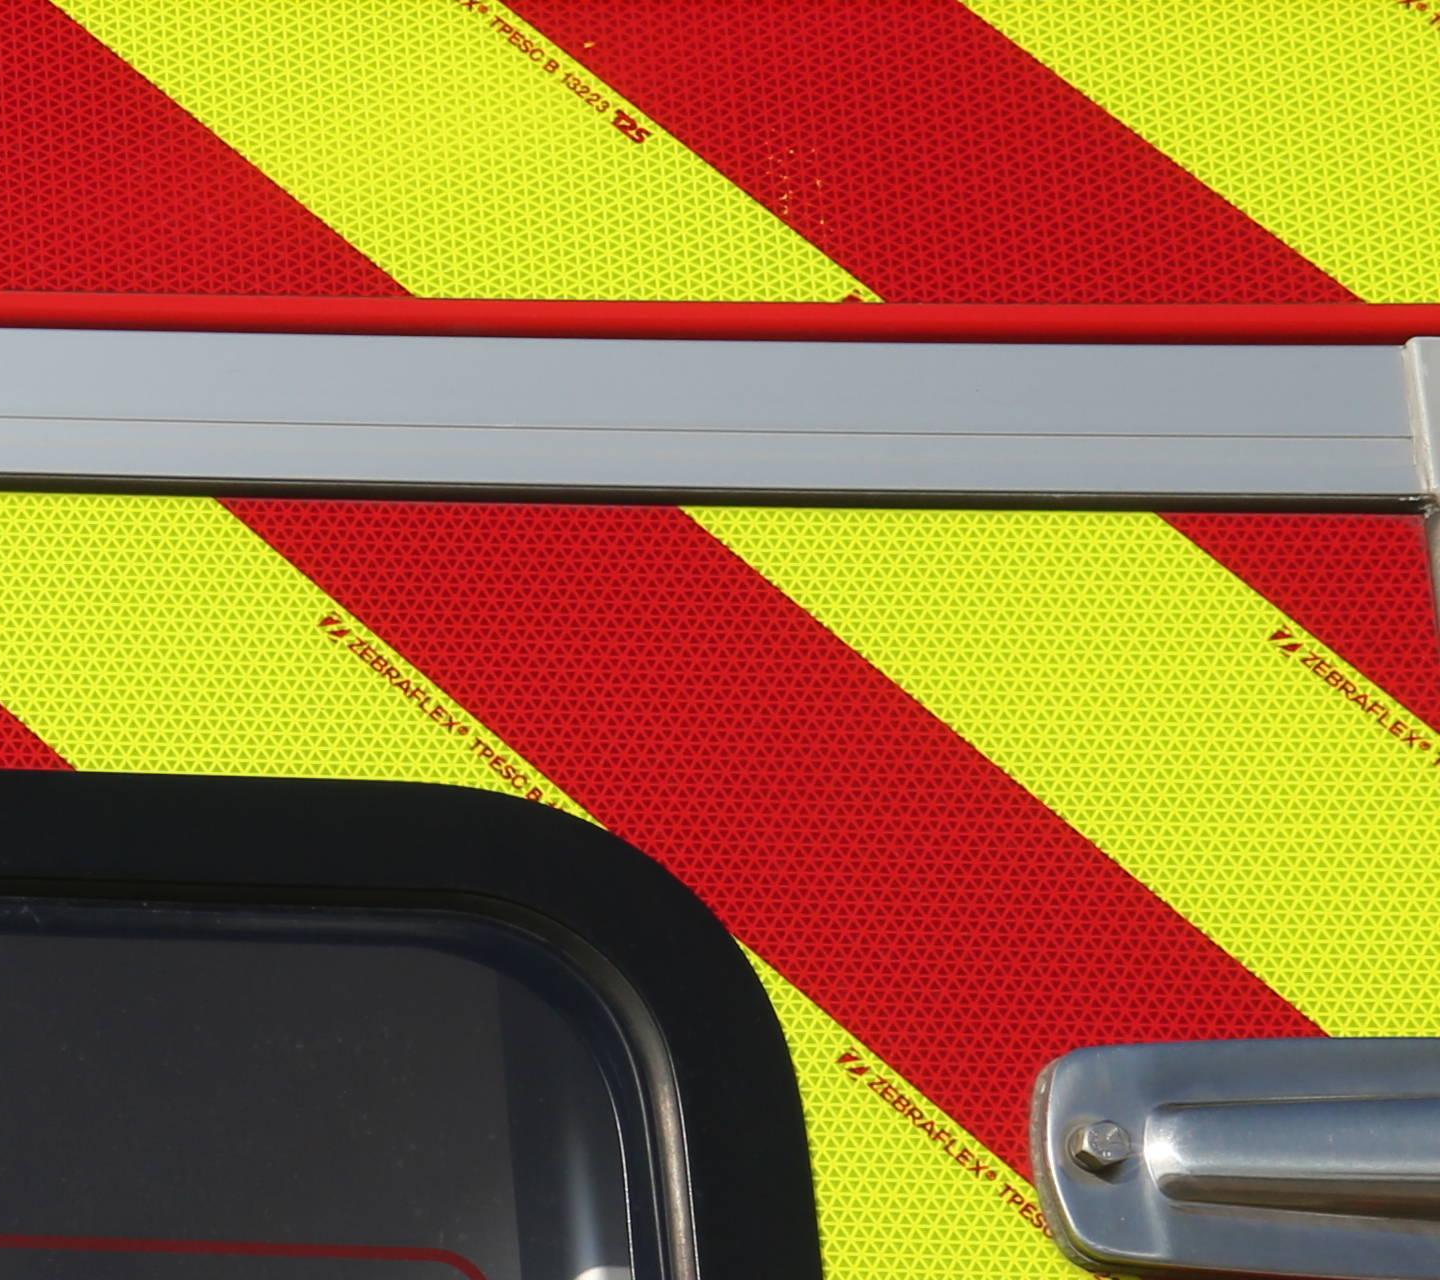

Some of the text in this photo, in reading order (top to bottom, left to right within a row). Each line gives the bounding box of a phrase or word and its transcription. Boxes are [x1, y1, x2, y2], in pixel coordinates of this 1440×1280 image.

[490, 14, 546, 63] TPESC
[542, 57, 561, 75] B
[561, 70, 612, 114] 13223
[472, 737, 529, 790] TPESC
[524, 786, 544, 804] B
